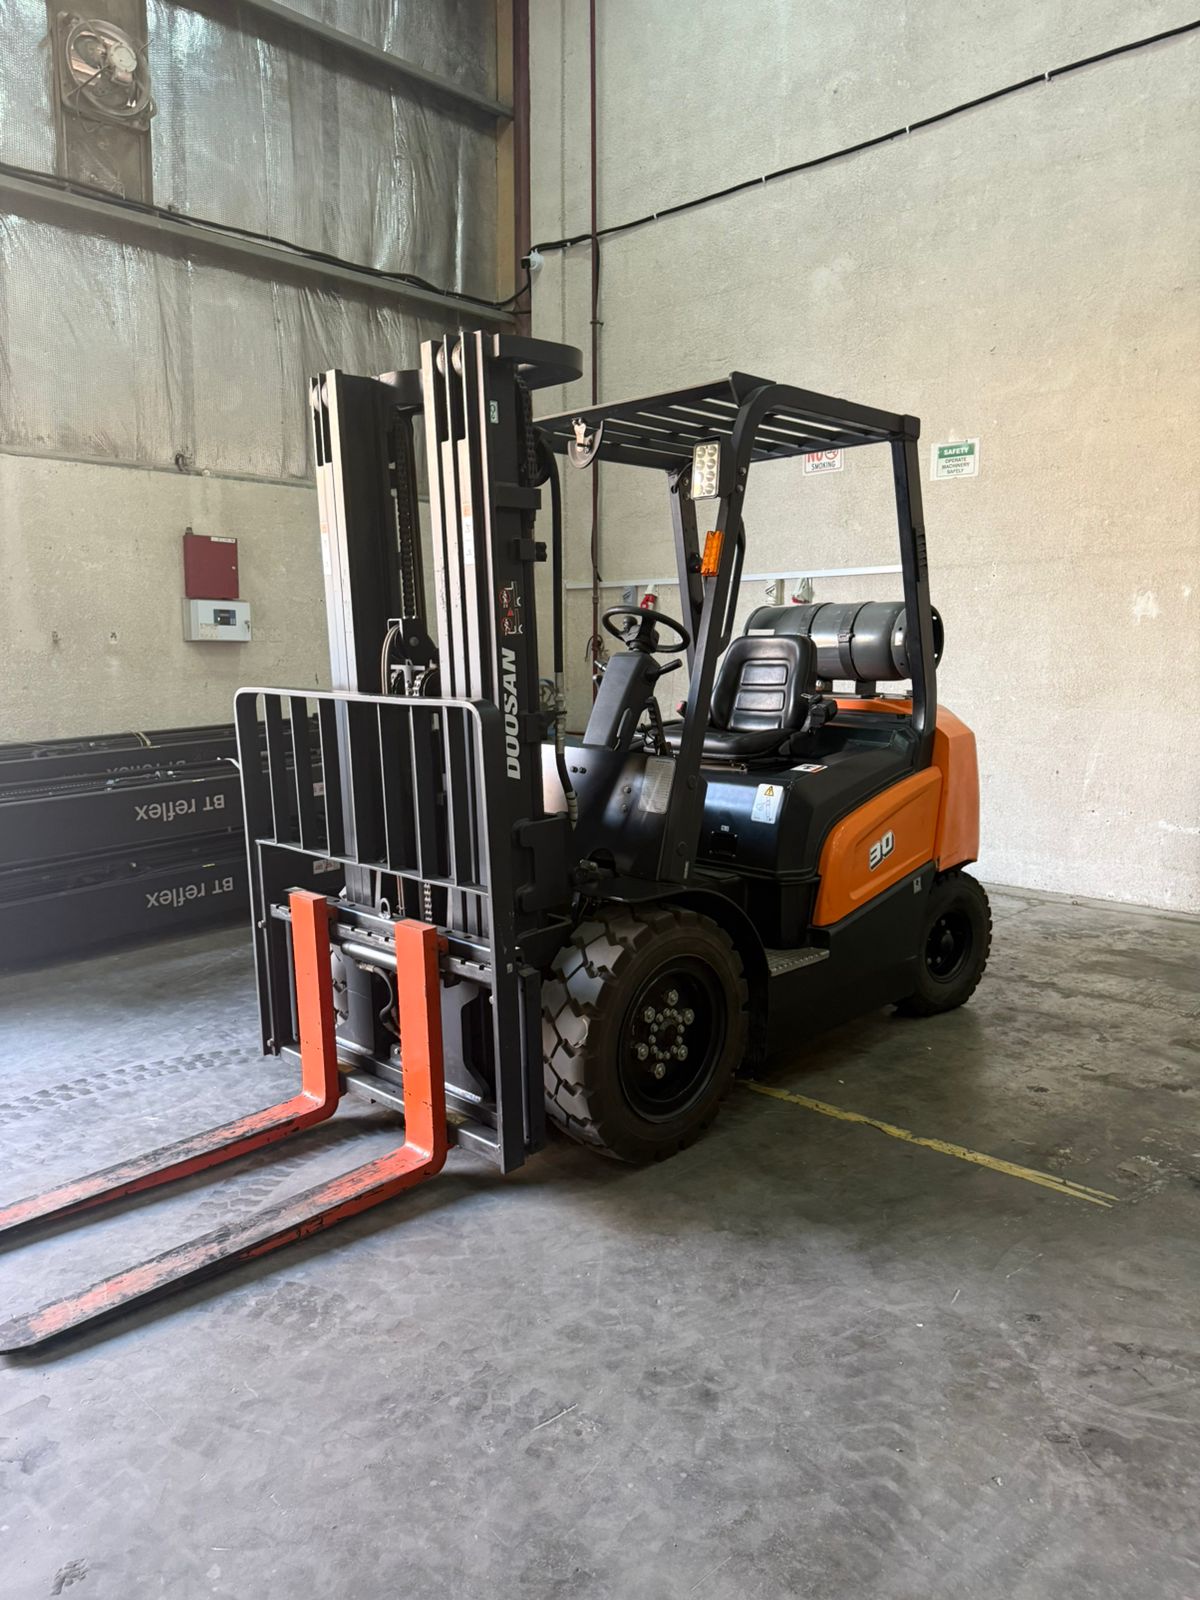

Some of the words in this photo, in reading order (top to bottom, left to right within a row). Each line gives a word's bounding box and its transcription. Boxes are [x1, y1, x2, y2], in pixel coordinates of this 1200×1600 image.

[807, 450, 823, 463] NO
[943, 447, 969, 455] SAFETY
[811, 460, 836, 470] SMOKING
[501, 647, 521, 780] DOOSAN
[134, 798, 196, 822] reflex
[203, 794, 225, 811] BT
[869, 830, 895, 871] 30
[212, 877, 233, 894] BT
[145, 882, 206, 908] reflex
